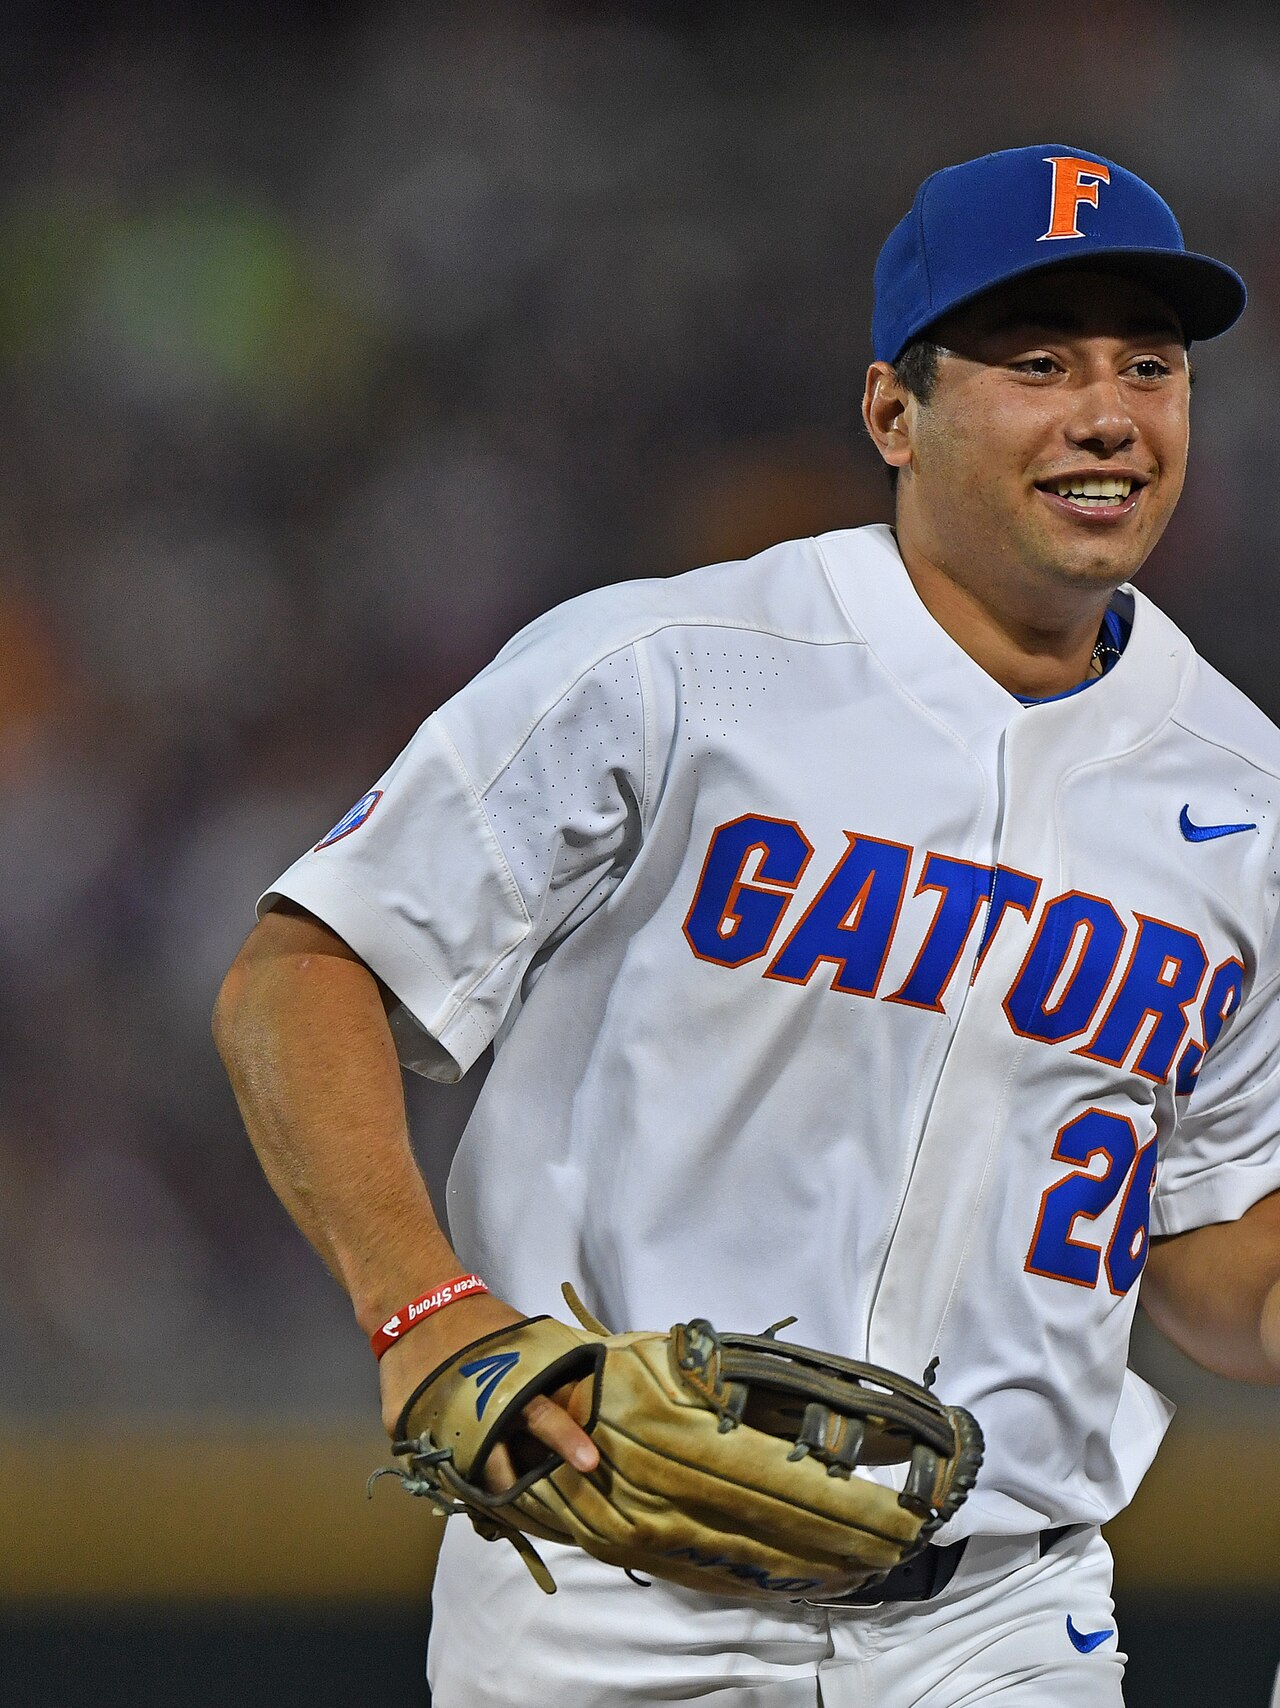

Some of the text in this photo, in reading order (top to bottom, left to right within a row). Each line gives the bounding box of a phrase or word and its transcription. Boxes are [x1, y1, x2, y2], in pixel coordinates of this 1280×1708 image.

[1036, 157, 1110, 241] F
[682, 813, 1246, 1096] GATORS
[1024, 1107, 1158, 1296] 26
[408, 1275, 488, 1320] rycen Strong
